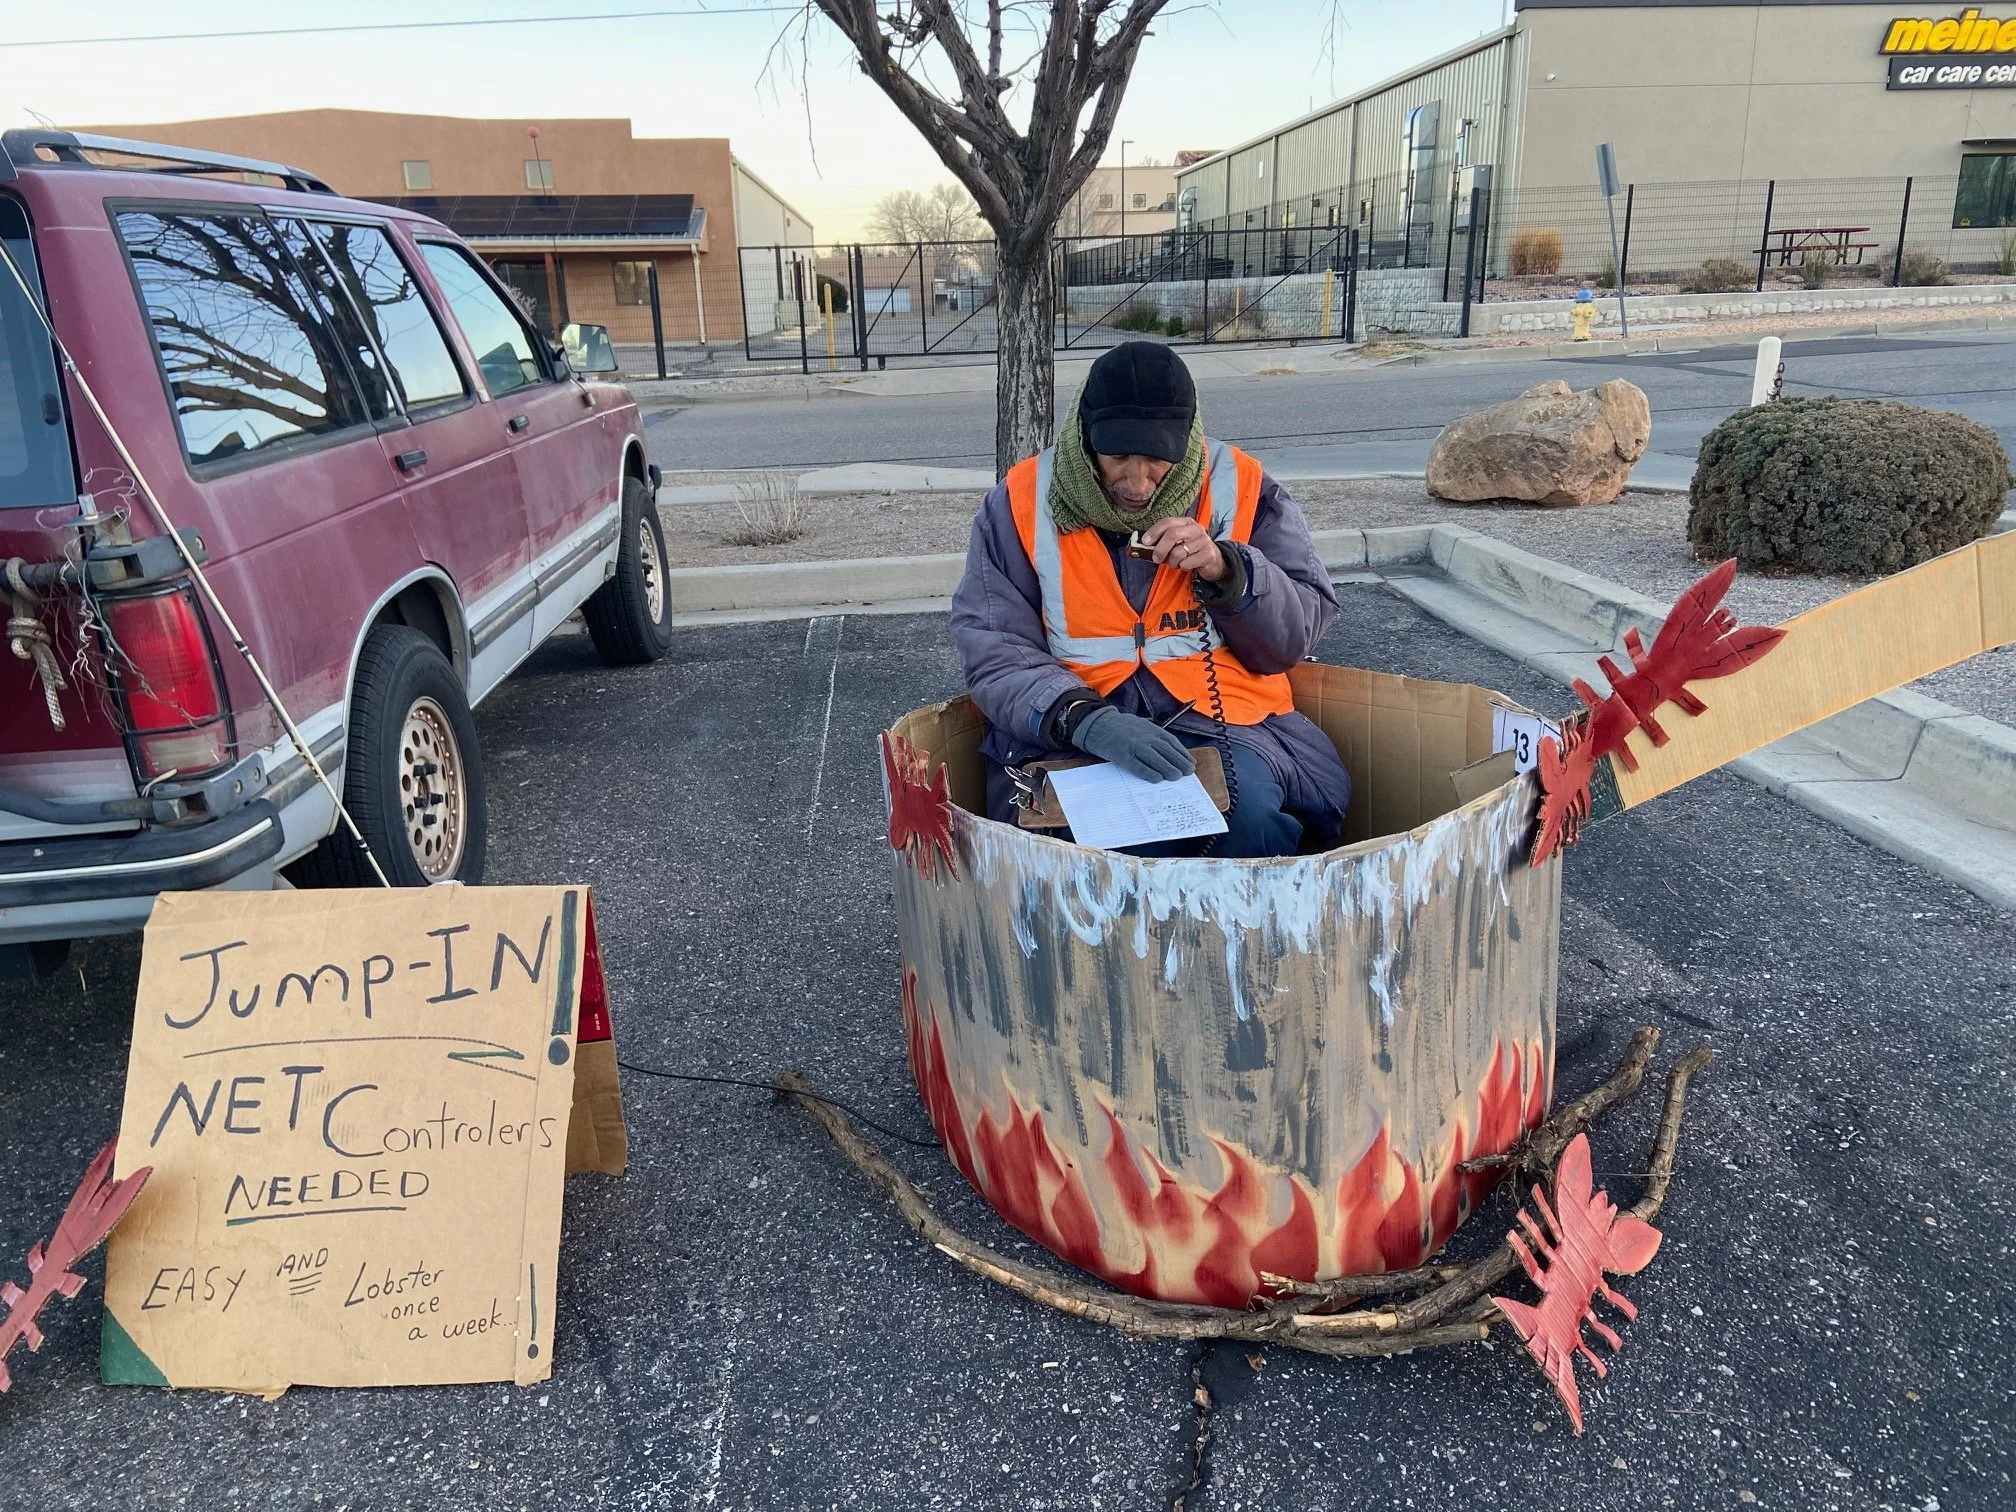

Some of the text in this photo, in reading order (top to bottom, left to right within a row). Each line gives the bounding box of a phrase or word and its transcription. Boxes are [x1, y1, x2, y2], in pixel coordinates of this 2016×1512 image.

[1899, 66, 1935, 84] car
[1936, 65, 1983, 84] care
[1512, 728, 1530, 764] 13
[225, 1169, 430, 1215] NEEDED
[141, 1247, 445, 1313] EASY AND Lobster
[391, 1295, 441, 1321] once
[408, 1324, 428, 1342] a
